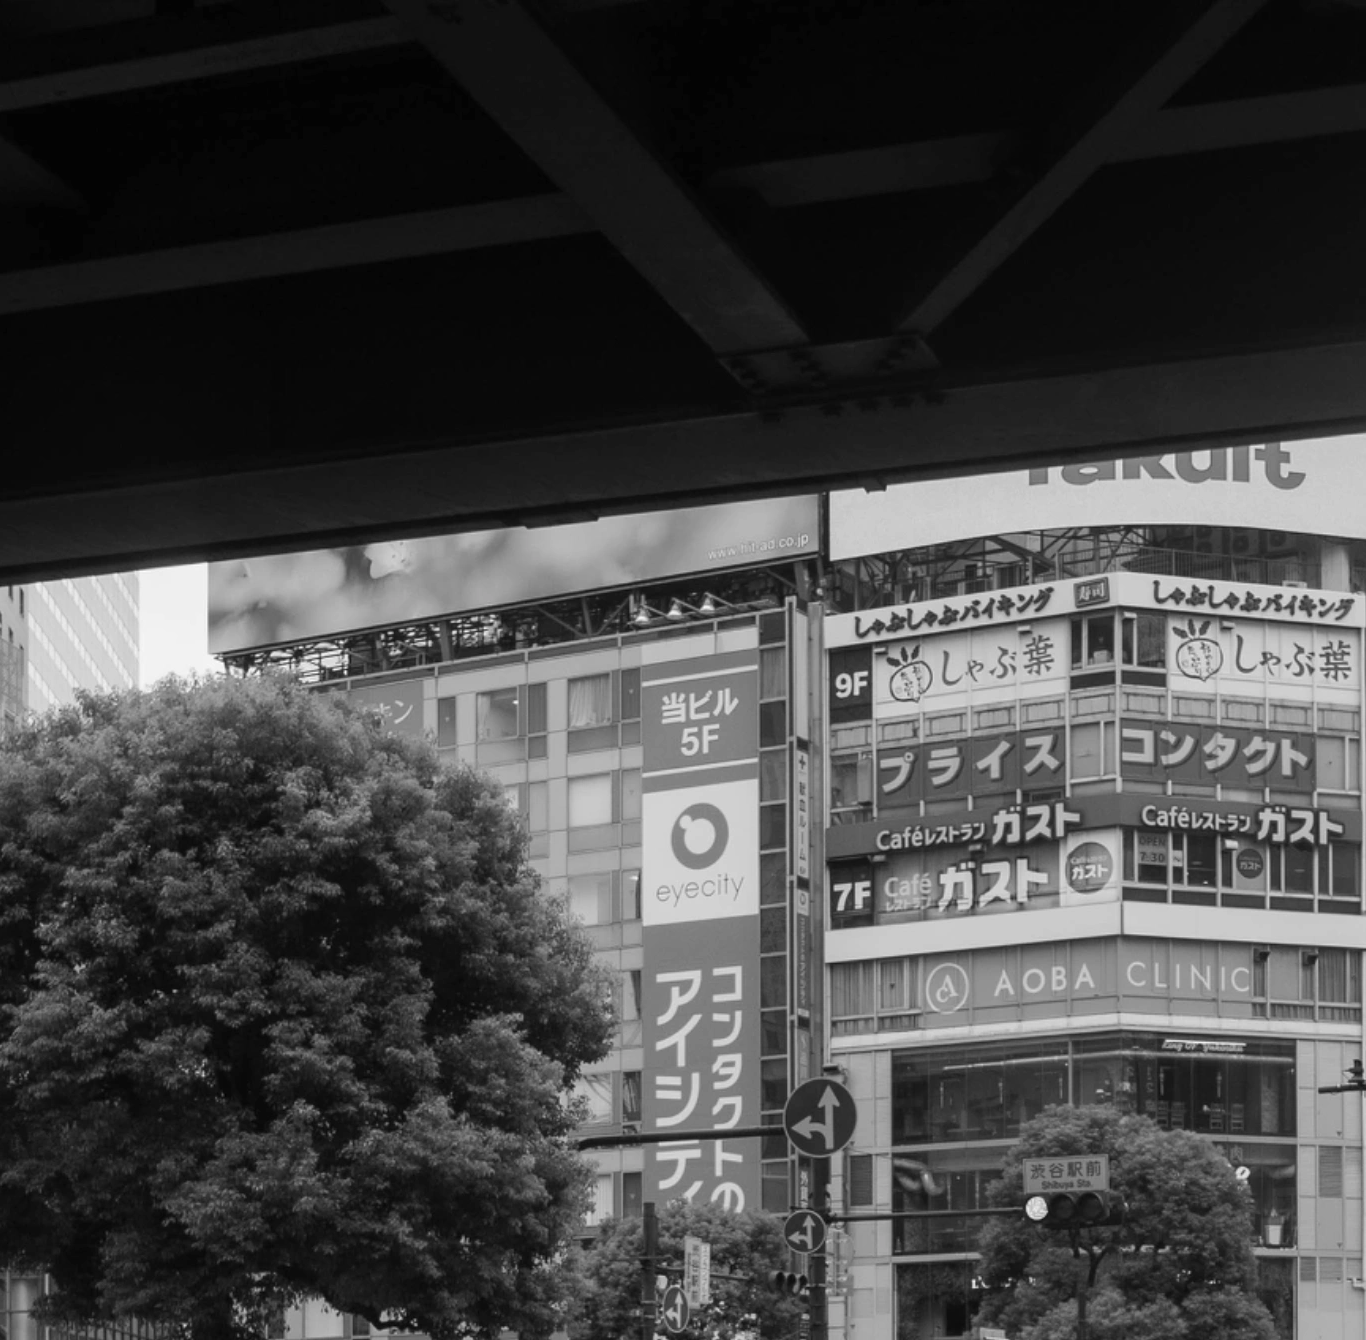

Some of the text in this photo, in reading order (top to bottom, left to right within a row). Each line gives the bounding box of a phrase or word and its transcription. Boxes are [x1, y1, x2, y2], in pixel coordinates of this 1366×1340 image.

[1029, 441, 1306, 490] akult
[855, 587, 1055, 638] しゃぶしゃぶバイキング
[1153, 580, 1355, 620] しゃぶしゃぶバイキング
[941, 635, 1055, 686] しゃぶ葉
[1236, 634, 1352, 682] しゃぶ葉
[835, 671, 869, 697] 9F
[662, 688, 739, 724] 当ビル
[680, 724, 720, 756] 5F
[1122, 728, 1308, 776] コンタクト
[880, 734, 1060, 793] プライス
[992, 803, 1080, 844] ガスト
[1258, 808, 1343, 845] ガスト
[1139, 836, 1166, 847] OPEN
[1071, 864, 1108, 881] ガスト
[1240, 861, 1261, 871] ガスト
[656, 874, 744, 908] eyecity
[834, 881, 871, 911] 7F
[885, 872, 932, 898] Café
[939, 859, 1048, 912] ガスト
[995, 962, 1250, 997] AOBA CLINIC
[1030, 1161, 1102, 1180] 渋谷駅前
[1041, 1180, 1074, 1191] Shibuya
